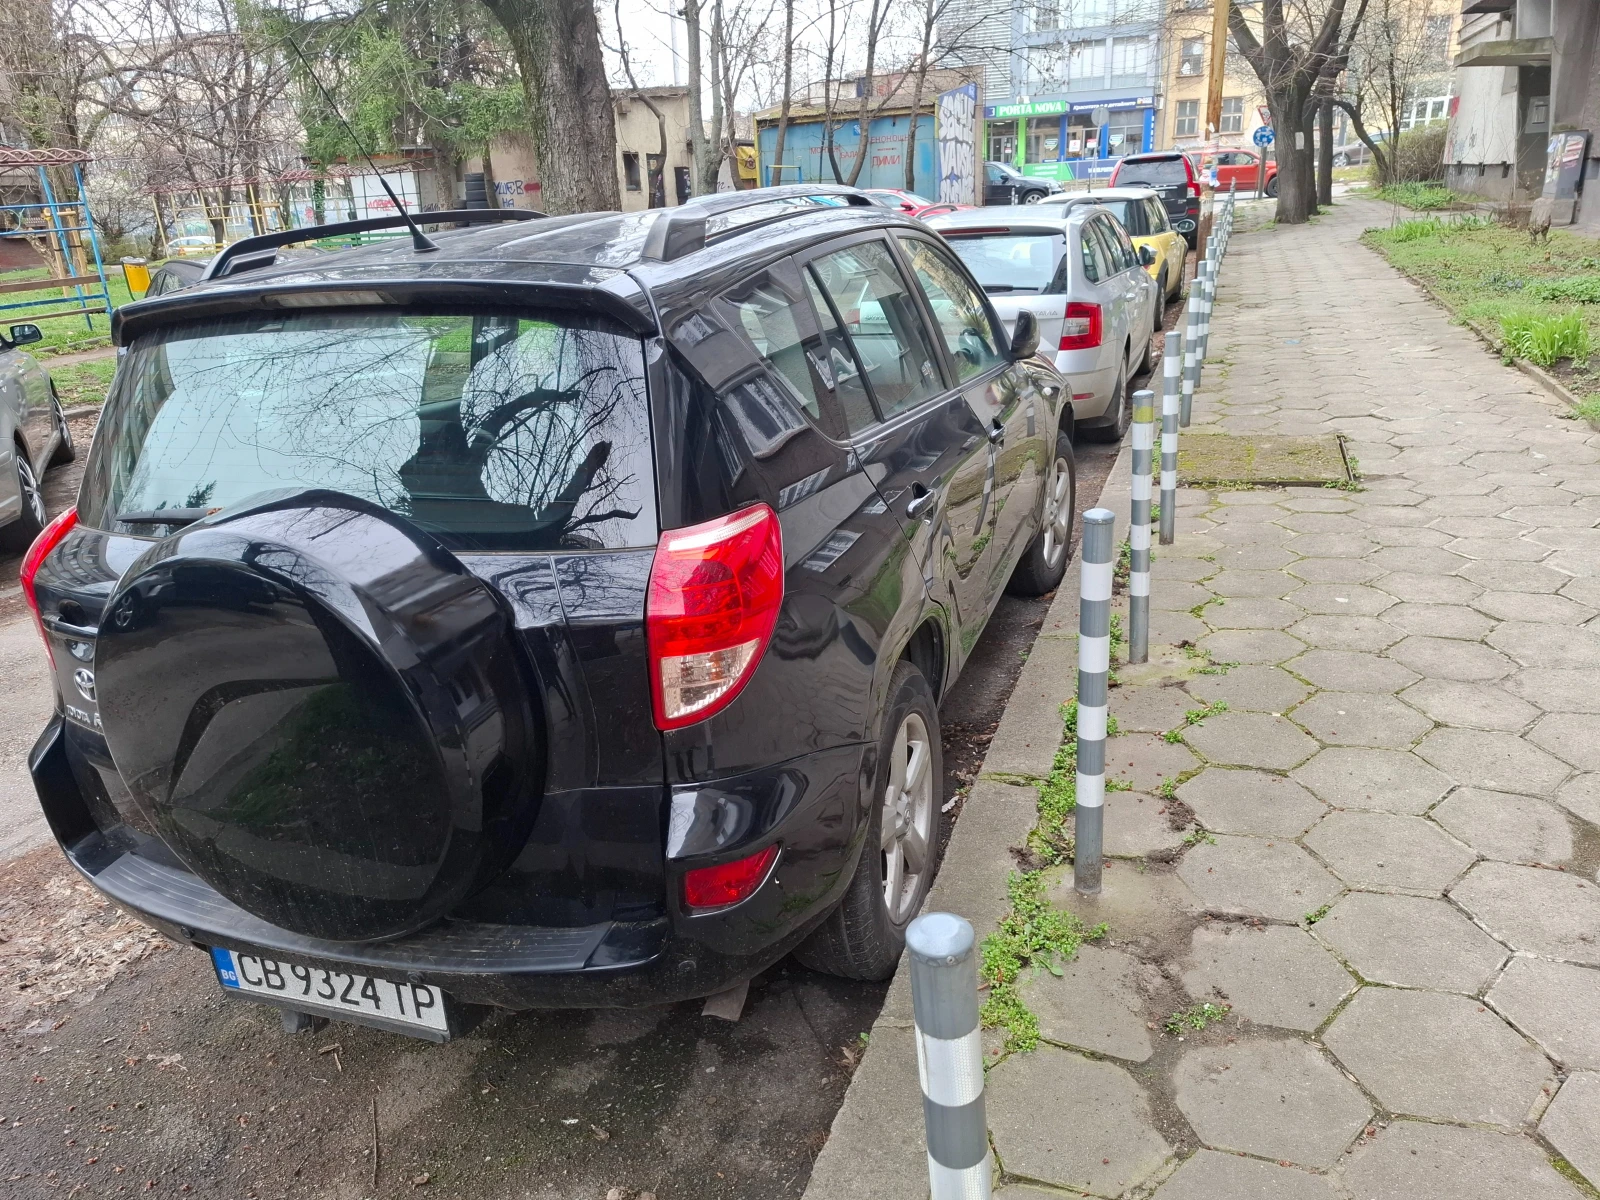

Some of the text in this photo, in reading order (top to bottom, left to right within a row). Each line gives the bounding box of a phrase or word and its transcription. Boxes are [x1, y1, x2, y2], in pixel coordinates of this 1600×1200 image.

[999, 101, 1063, 116] PORTA NOVA
[502, 197, 515, 208] НА
[220, 968, 237, 981] BG
[237, 952, 435, 1019] CB 9324 TP
